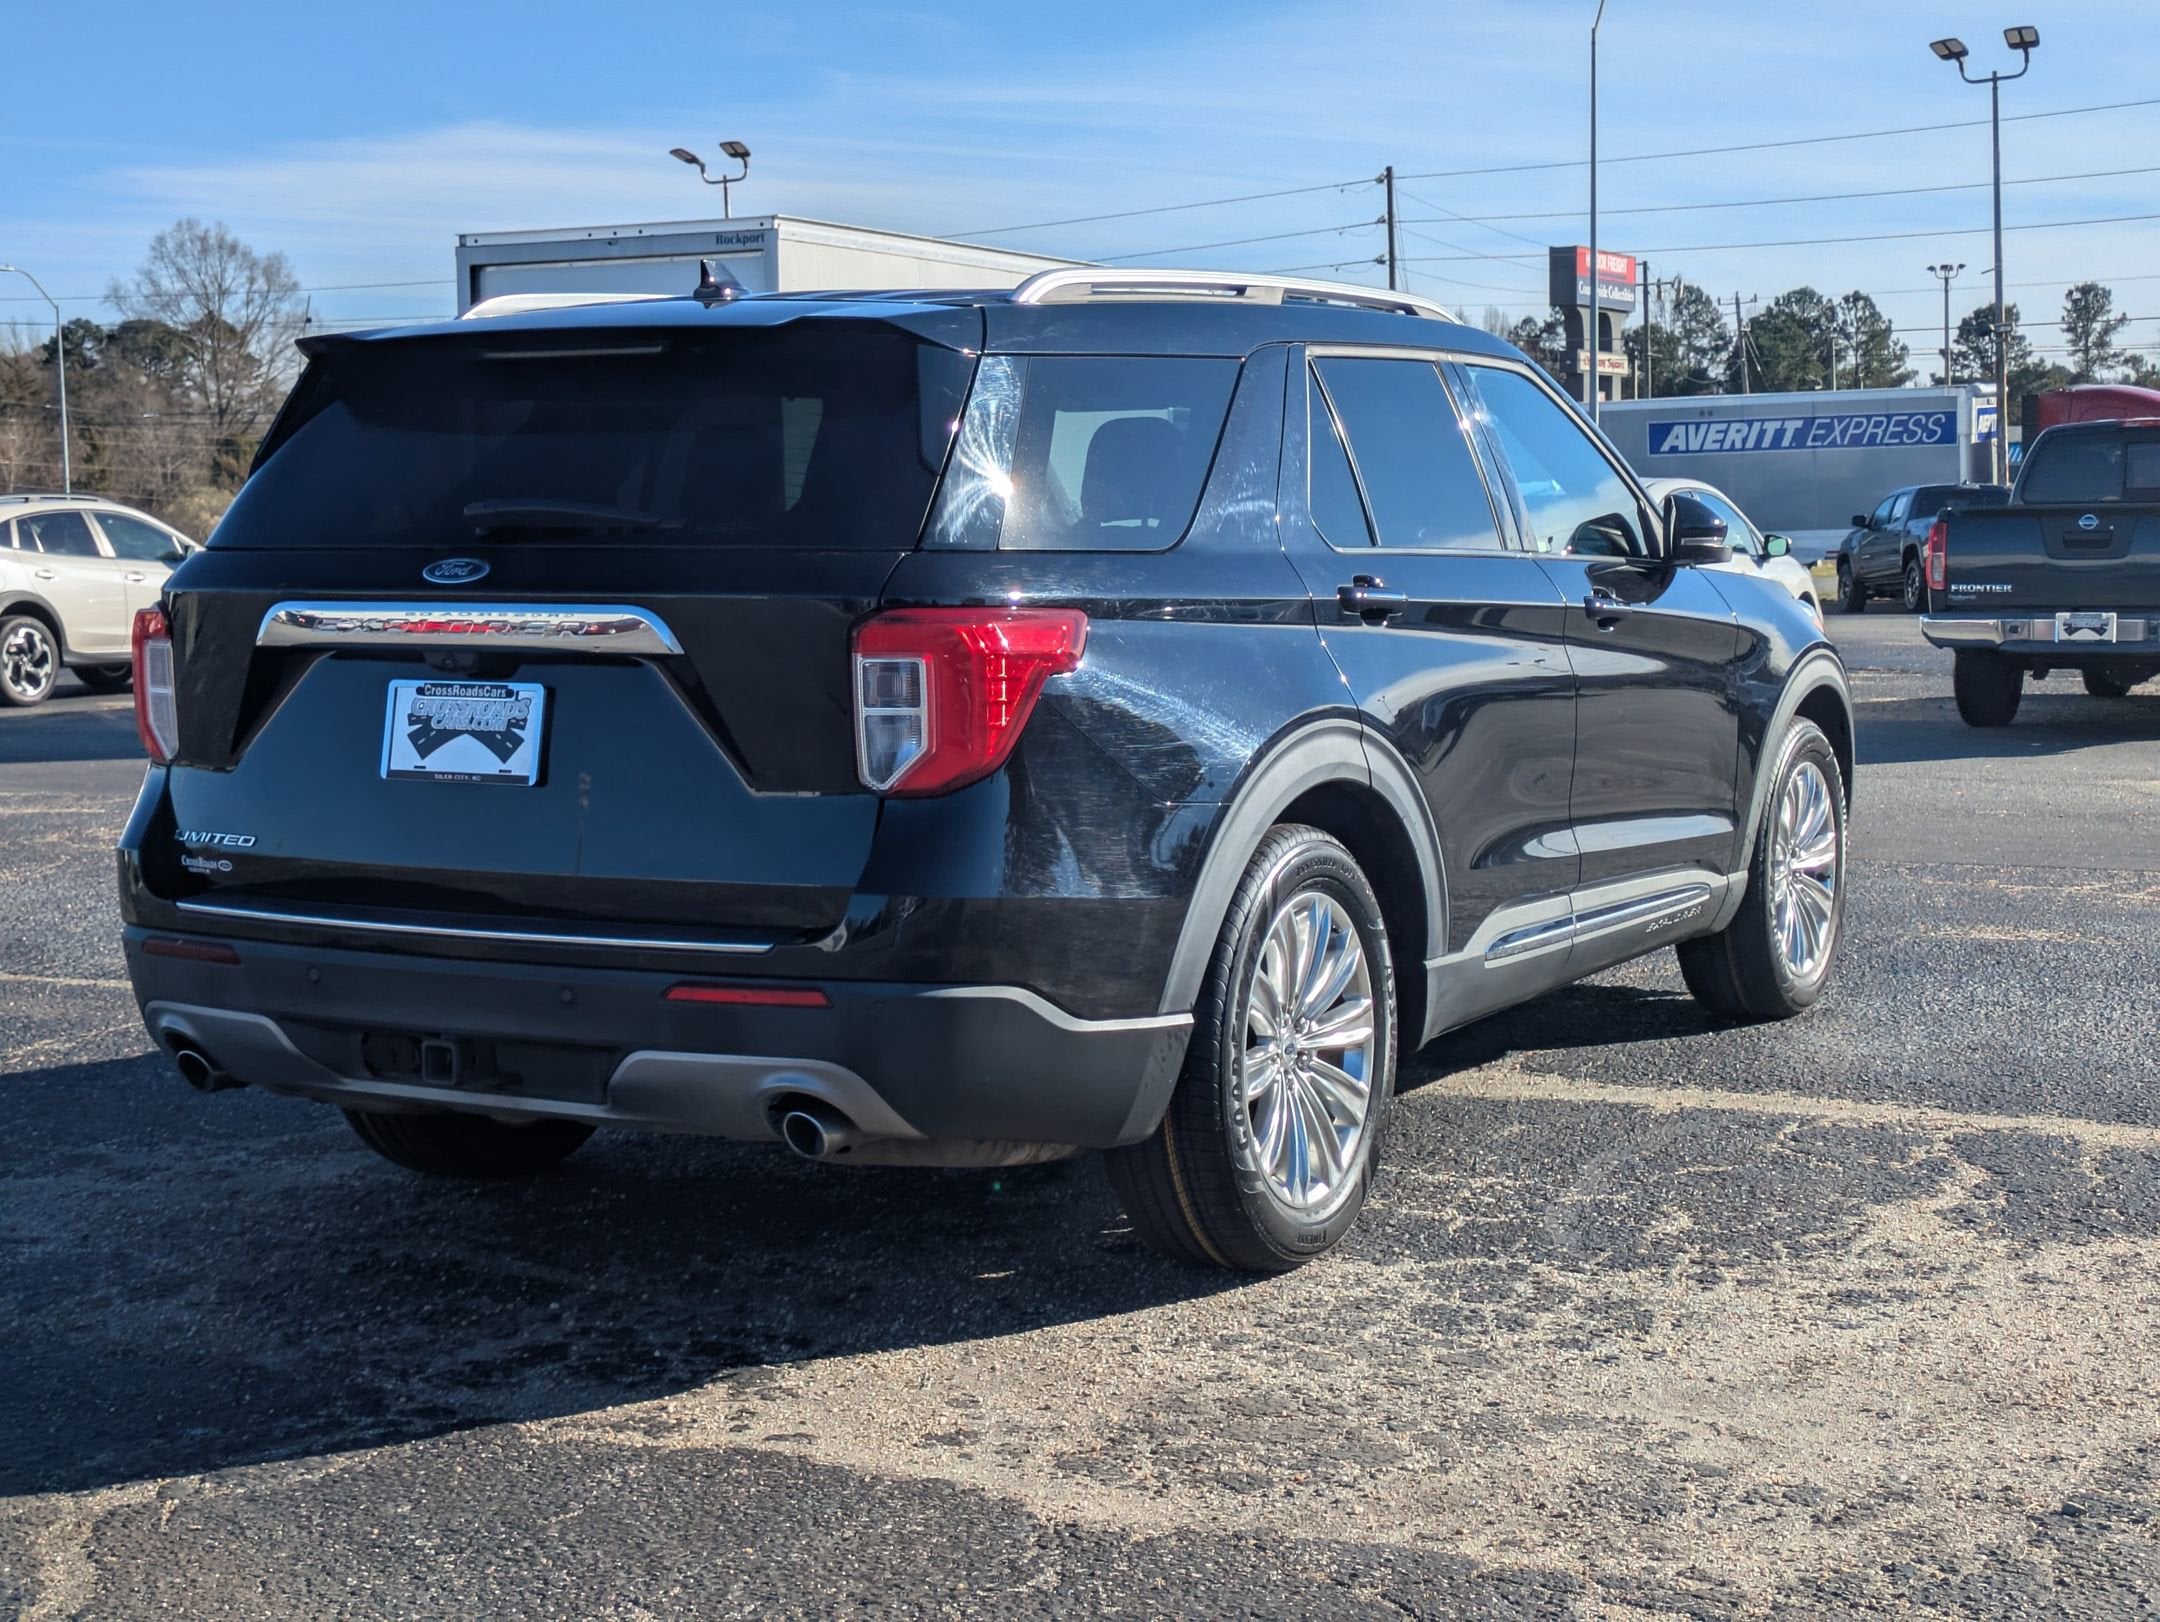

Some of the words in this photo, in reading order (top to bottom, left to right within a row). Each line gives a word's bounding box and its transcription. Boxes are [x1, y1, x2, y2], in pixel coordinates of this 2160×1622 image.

[715, 232, 765, 247] Rockport
[1660, 418, 1803, 452] AVERITT
[1806, 414, 1946, 447] EXPRESS
[434, 561, 475, 577] Ford
[1950, 583, 2013, 593] FRONTIER
[312, 617, 588, 639] EXPLORER
[424, 684, 507, 699] CrossRoadsCars
[411, 697, 532, 720] CROSSROADS
